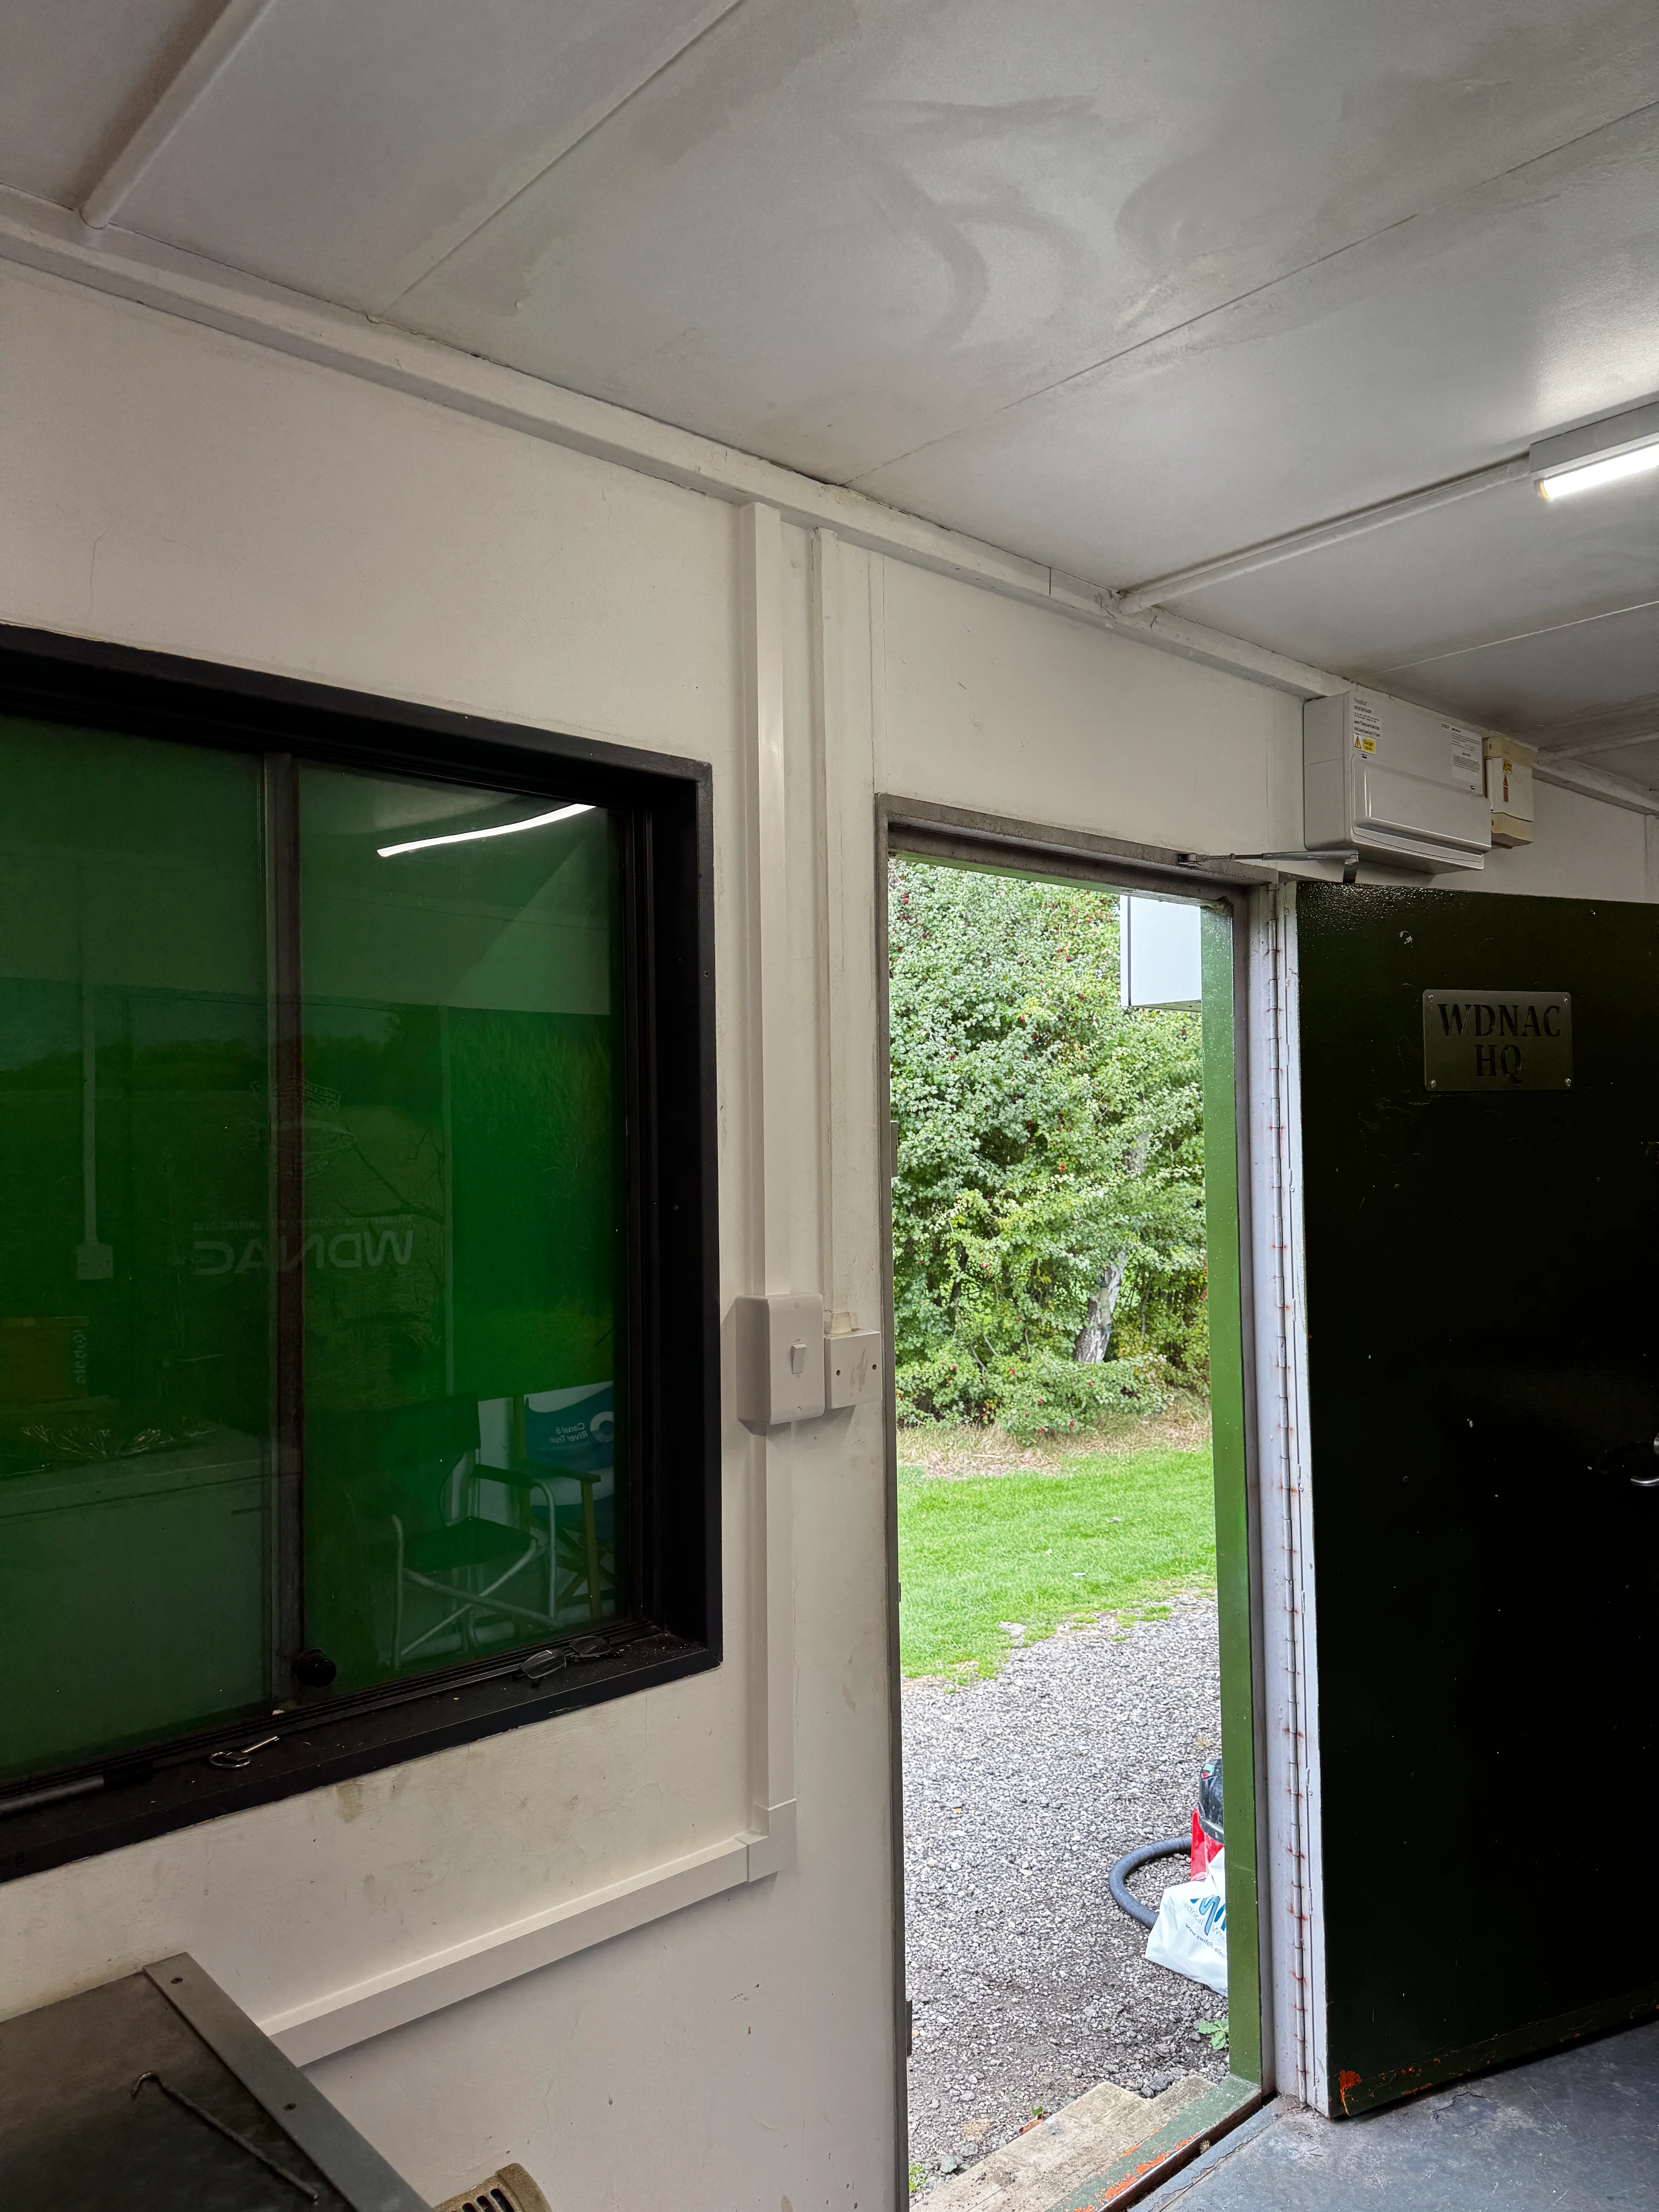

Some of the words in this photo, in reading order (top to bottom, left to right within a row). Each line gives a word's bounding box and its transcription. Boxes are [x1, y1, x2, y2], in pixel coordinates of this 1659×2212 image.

[1437, 1004, 1561, 1037] WDNAC
[1474, 1044, 1523, 1085] HQ
[1182, 1901, 1204, 1925] ectrical
